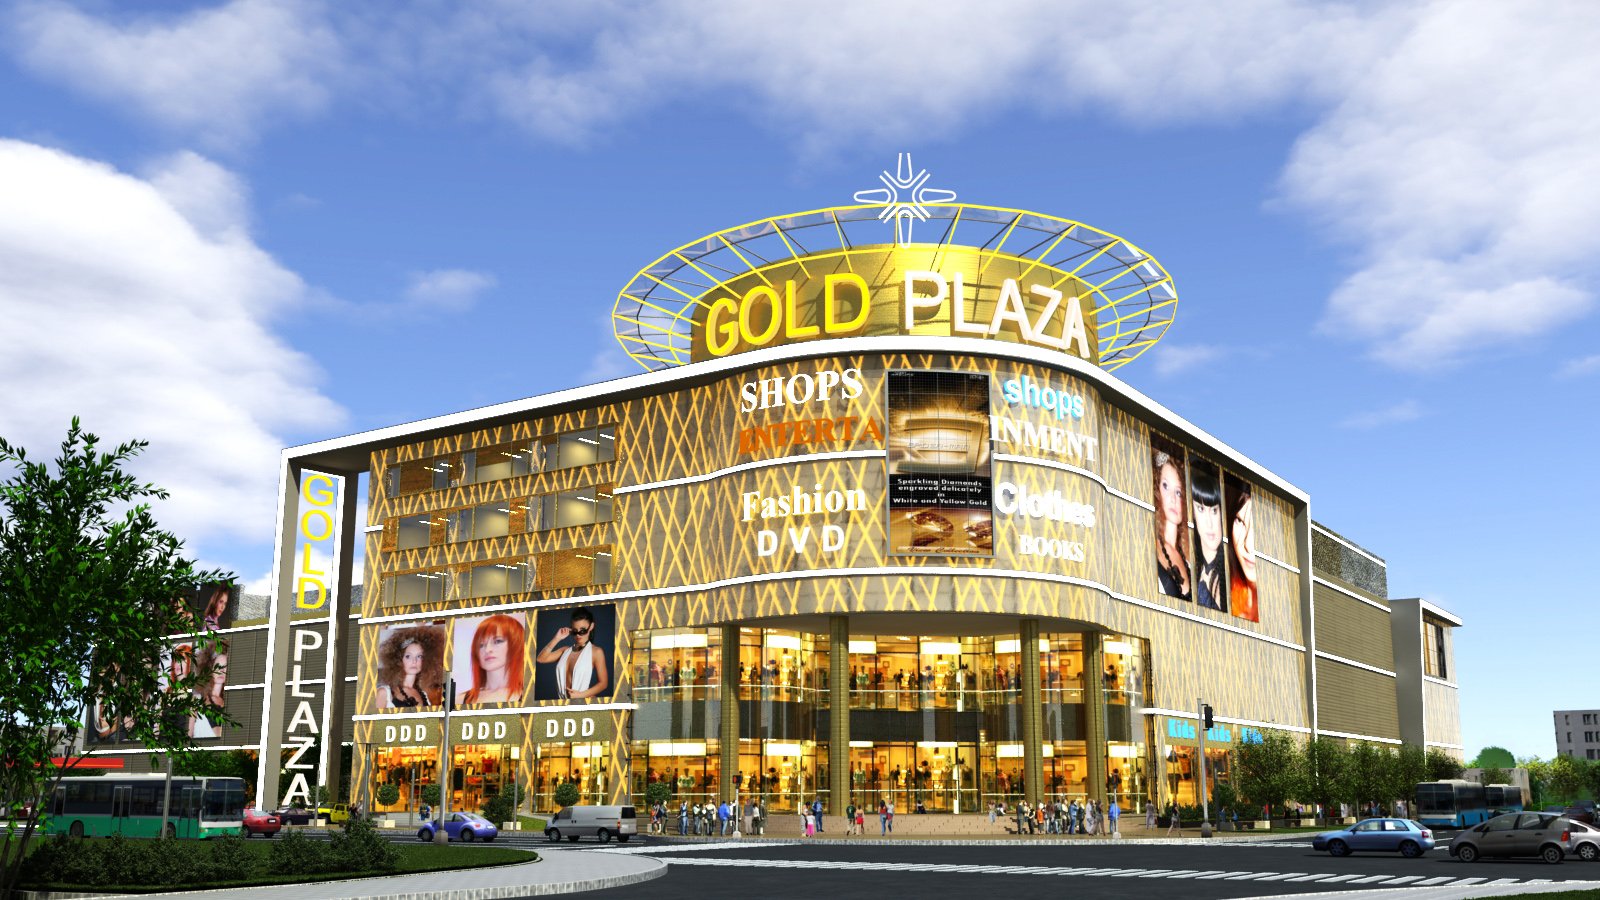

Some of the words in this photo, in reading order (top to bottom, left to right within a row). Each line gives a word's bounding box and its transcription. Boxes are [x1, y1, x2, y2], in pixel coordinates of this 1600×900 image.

[706, 272, 871, 357] GOLD
[904, 269, 1091, 359] PLAZA
[740, 368, 864, 413] SHOPS
[1003, 375, 1085, 420] shops
[740, 484, 867, 522] Fashion
[941, 479, 982, 487] Diamonds
[994, 481, 1096, 529] Clothes
[296, 474, 334, 609] GOLD
[1018, 534, 1085, 563] BOOKS
[282, 629, 323, 806] PLAZA
[1168, 718, 1195, 739] Kids
